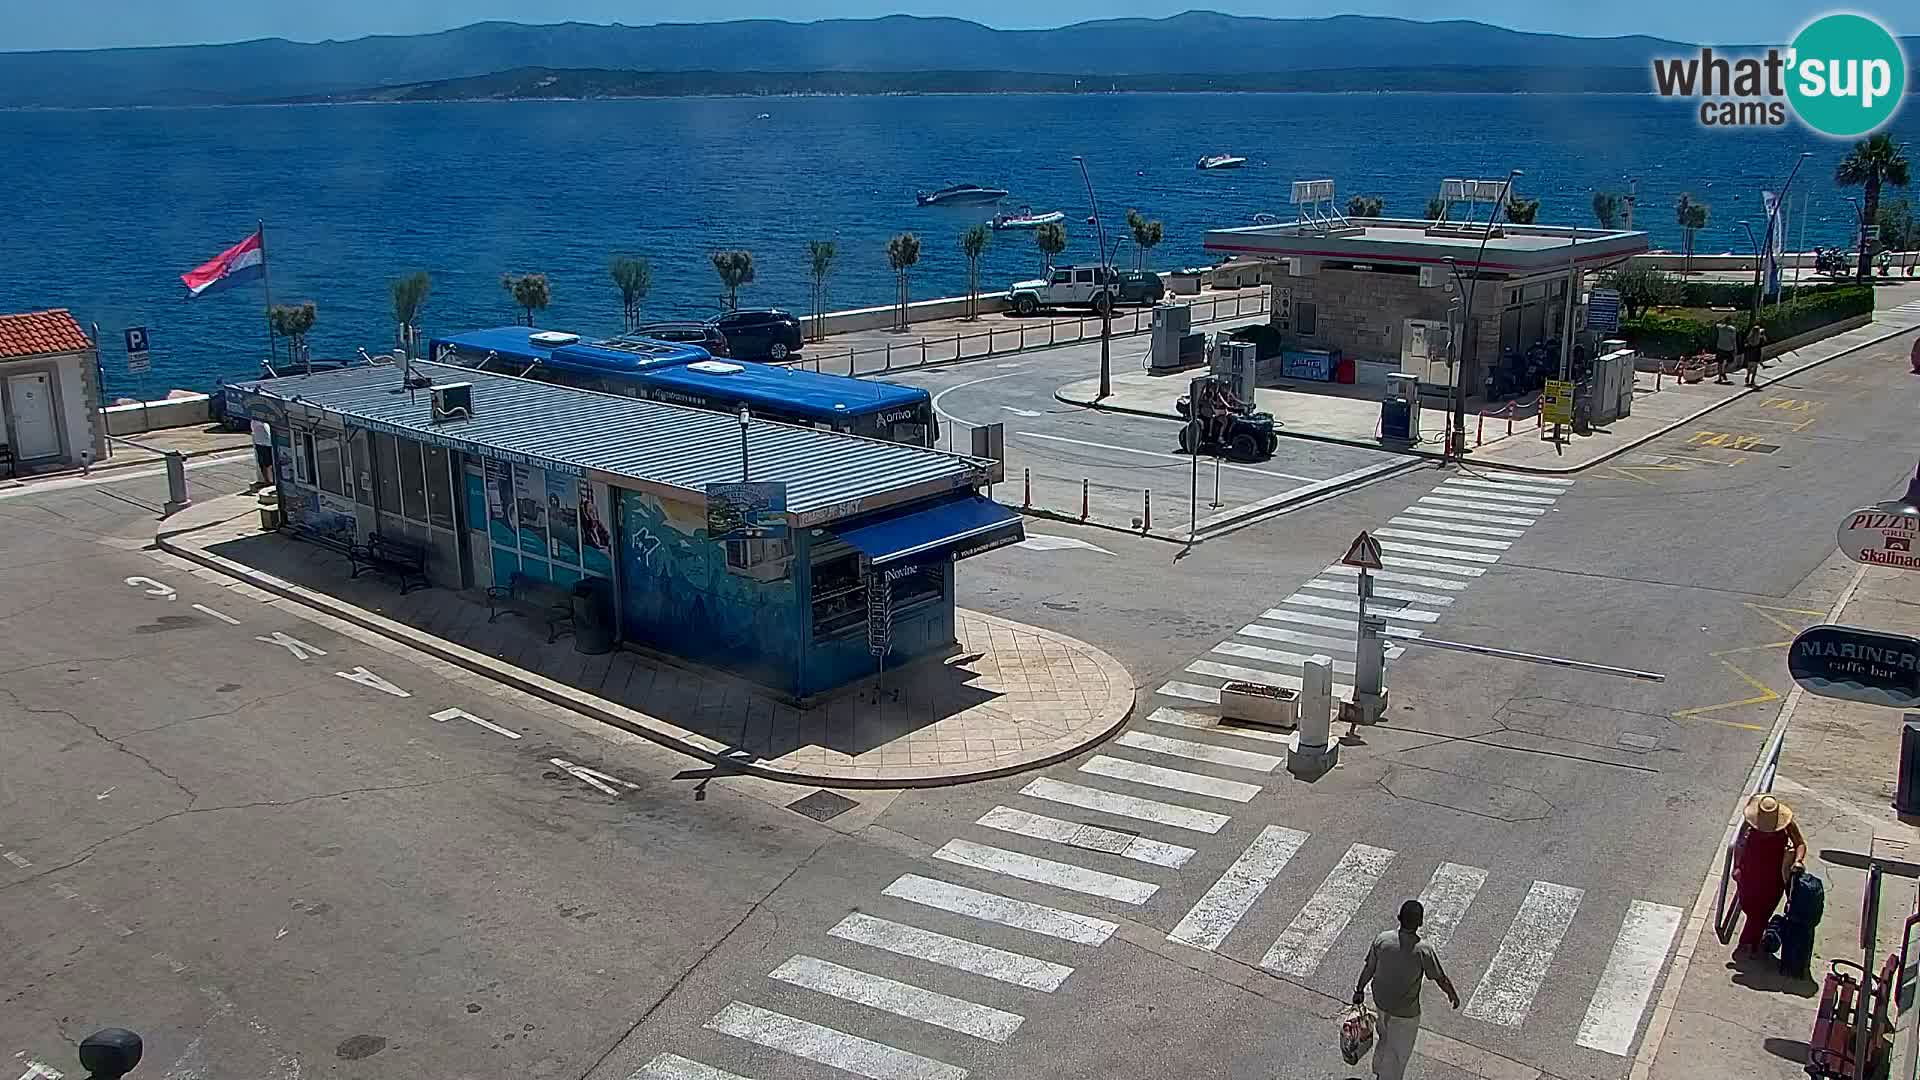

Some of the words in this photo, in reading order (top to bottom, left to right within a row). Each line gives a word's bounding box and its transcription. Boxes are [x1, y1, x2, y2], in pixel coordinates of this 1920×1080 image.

[129, 330, 142, 348] P
[886, 409, 911, 423] arriva
[1687, 432, 1764, 449] TAXI
[494, 449, 526, 464] STATION
[528, 456, 553, 470] TICKET
[555, 463, 583, 476] OFFICE
[1848, 514, 1920, 531] PIZZE
[1881, 529, 1916, 539] GRILL
[1829, 661, 1865, 673] caffe
[1871, 664, 1897, 679] bar
